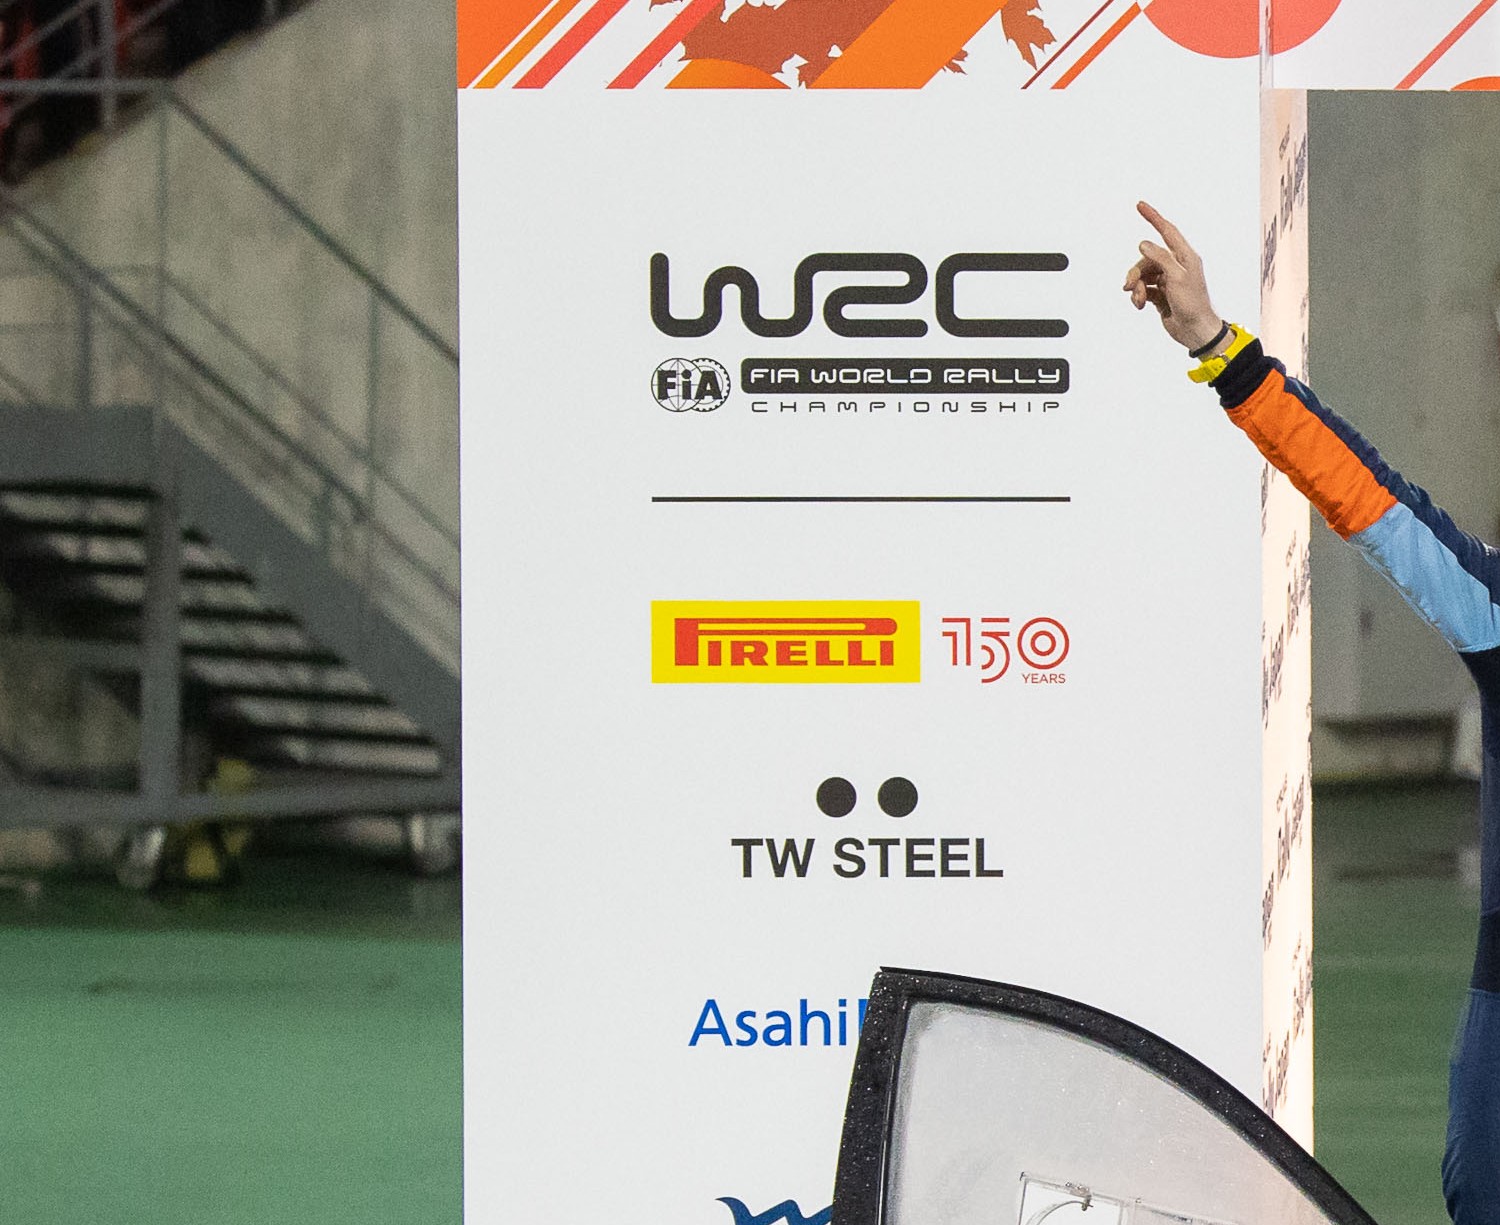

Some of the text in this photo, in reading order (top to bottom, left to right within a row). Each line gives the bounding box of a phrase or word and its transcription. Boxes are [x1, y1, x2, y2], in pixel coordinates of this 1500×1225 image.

[650, 252, 1070, 338] WRC
[657, 368, 724, 401] FIA
[751, 368, 1061, 385] FIA WORLD RALLY
[751, 401, 1061, 413] CHAMPIONSHIP
[674, 617, 898, 667] PIRELLI
[1021, 673, 1066, 685] YEARS
[731, 836, 1005, 879] TW STEEL
